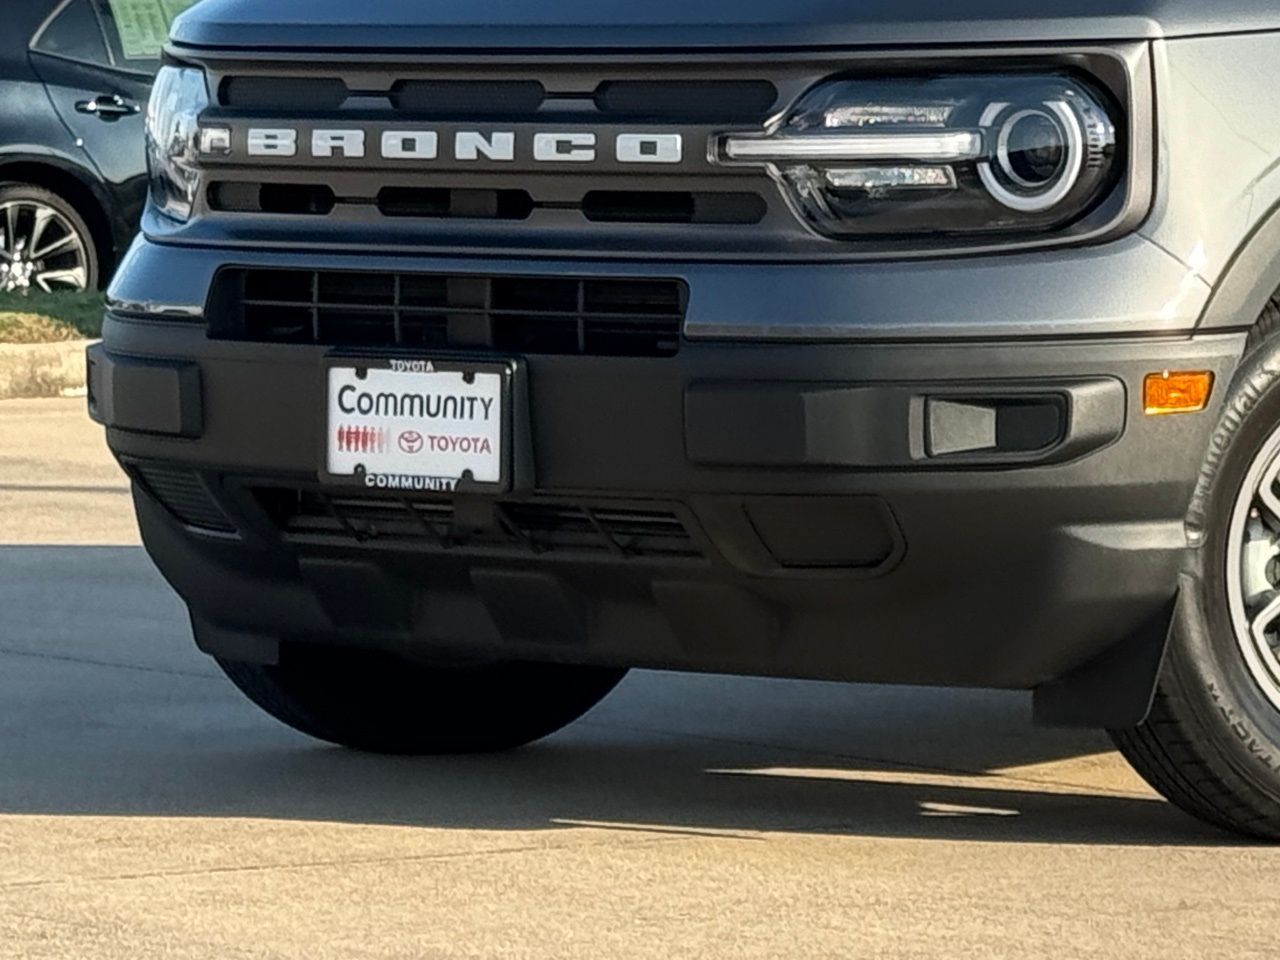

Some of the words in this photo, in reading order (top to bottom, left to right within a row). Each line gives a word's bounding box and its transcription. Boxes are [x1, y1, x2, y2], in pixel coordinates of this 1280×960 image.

[247, 127, 683, 163] BRONCO
[389, 359, 435, 373] TOYOTA
[427, 434, 492, 454] TOYOTA
[364, 474, 458, 491] COMMUNITY
